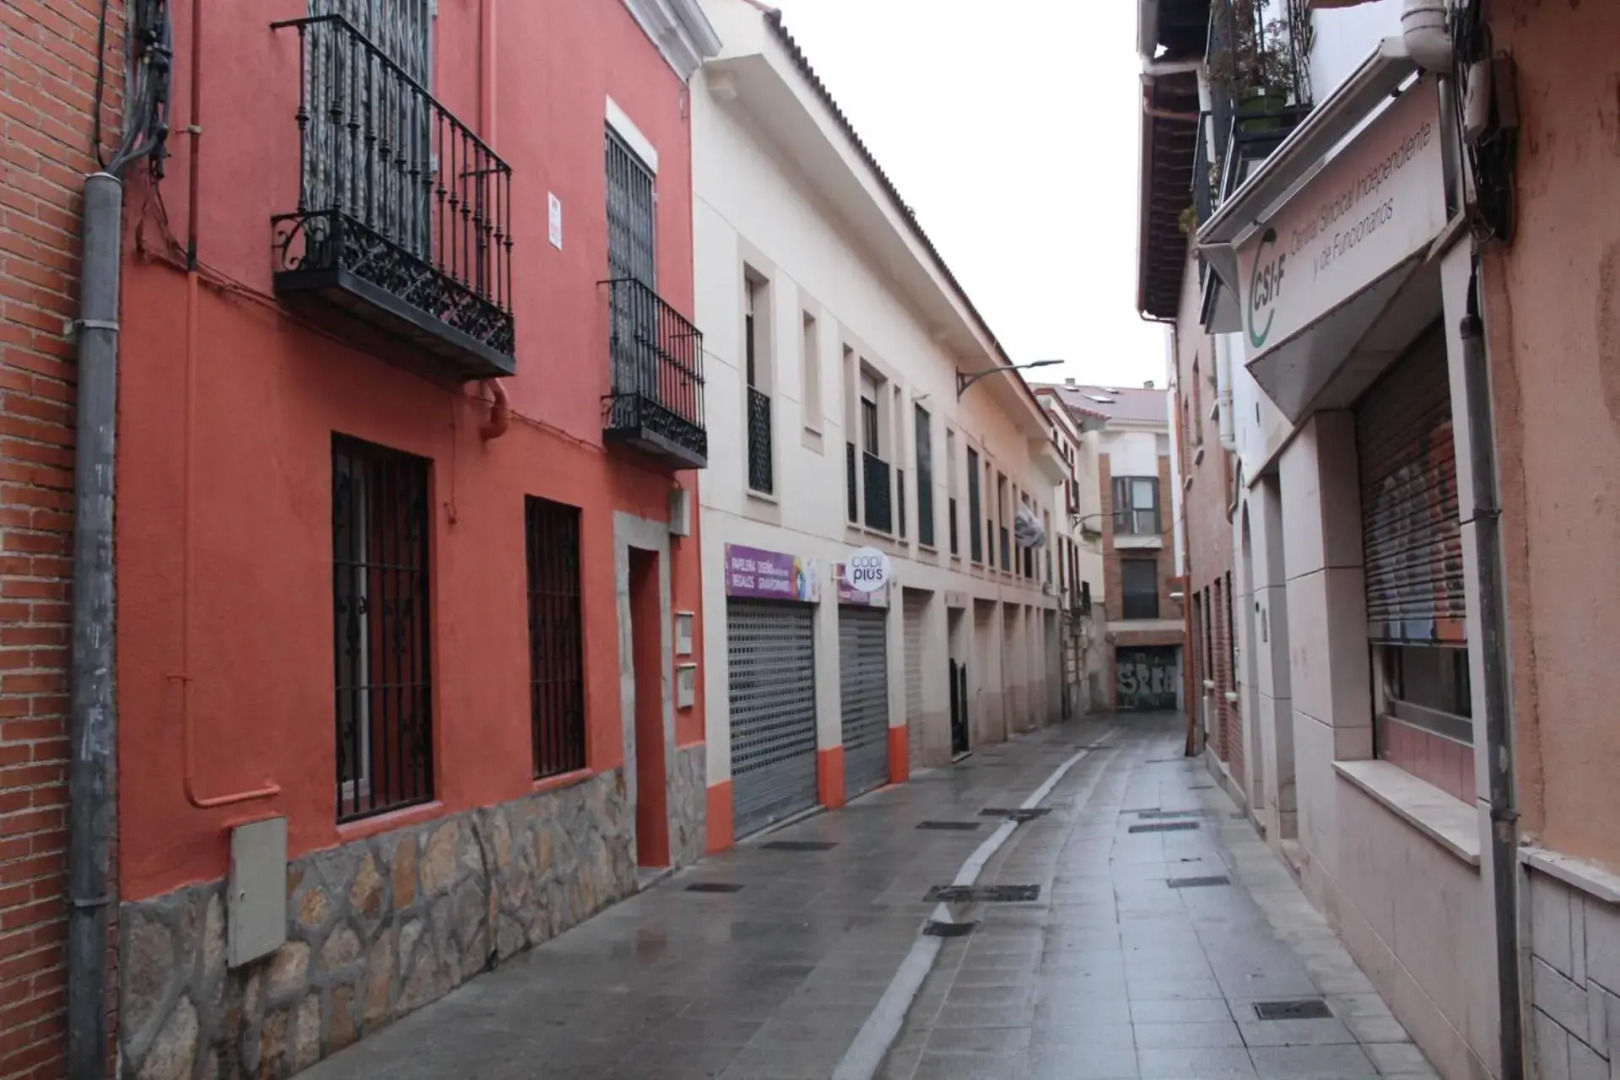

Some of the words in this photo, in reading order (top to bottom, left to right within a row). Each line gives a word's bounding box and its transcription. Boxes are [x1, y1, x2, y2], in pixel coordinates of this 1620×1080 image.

[1290, 218, 1319, 258] Central
[1319, 181, 1355, 233] Sindical
[1355, 121, 1432, 205] Independiente
[1320, 245, 1332, 271] de
[1333, 196, 1395, 261] Funcionarios
[853, 567, 884, 585] plus
